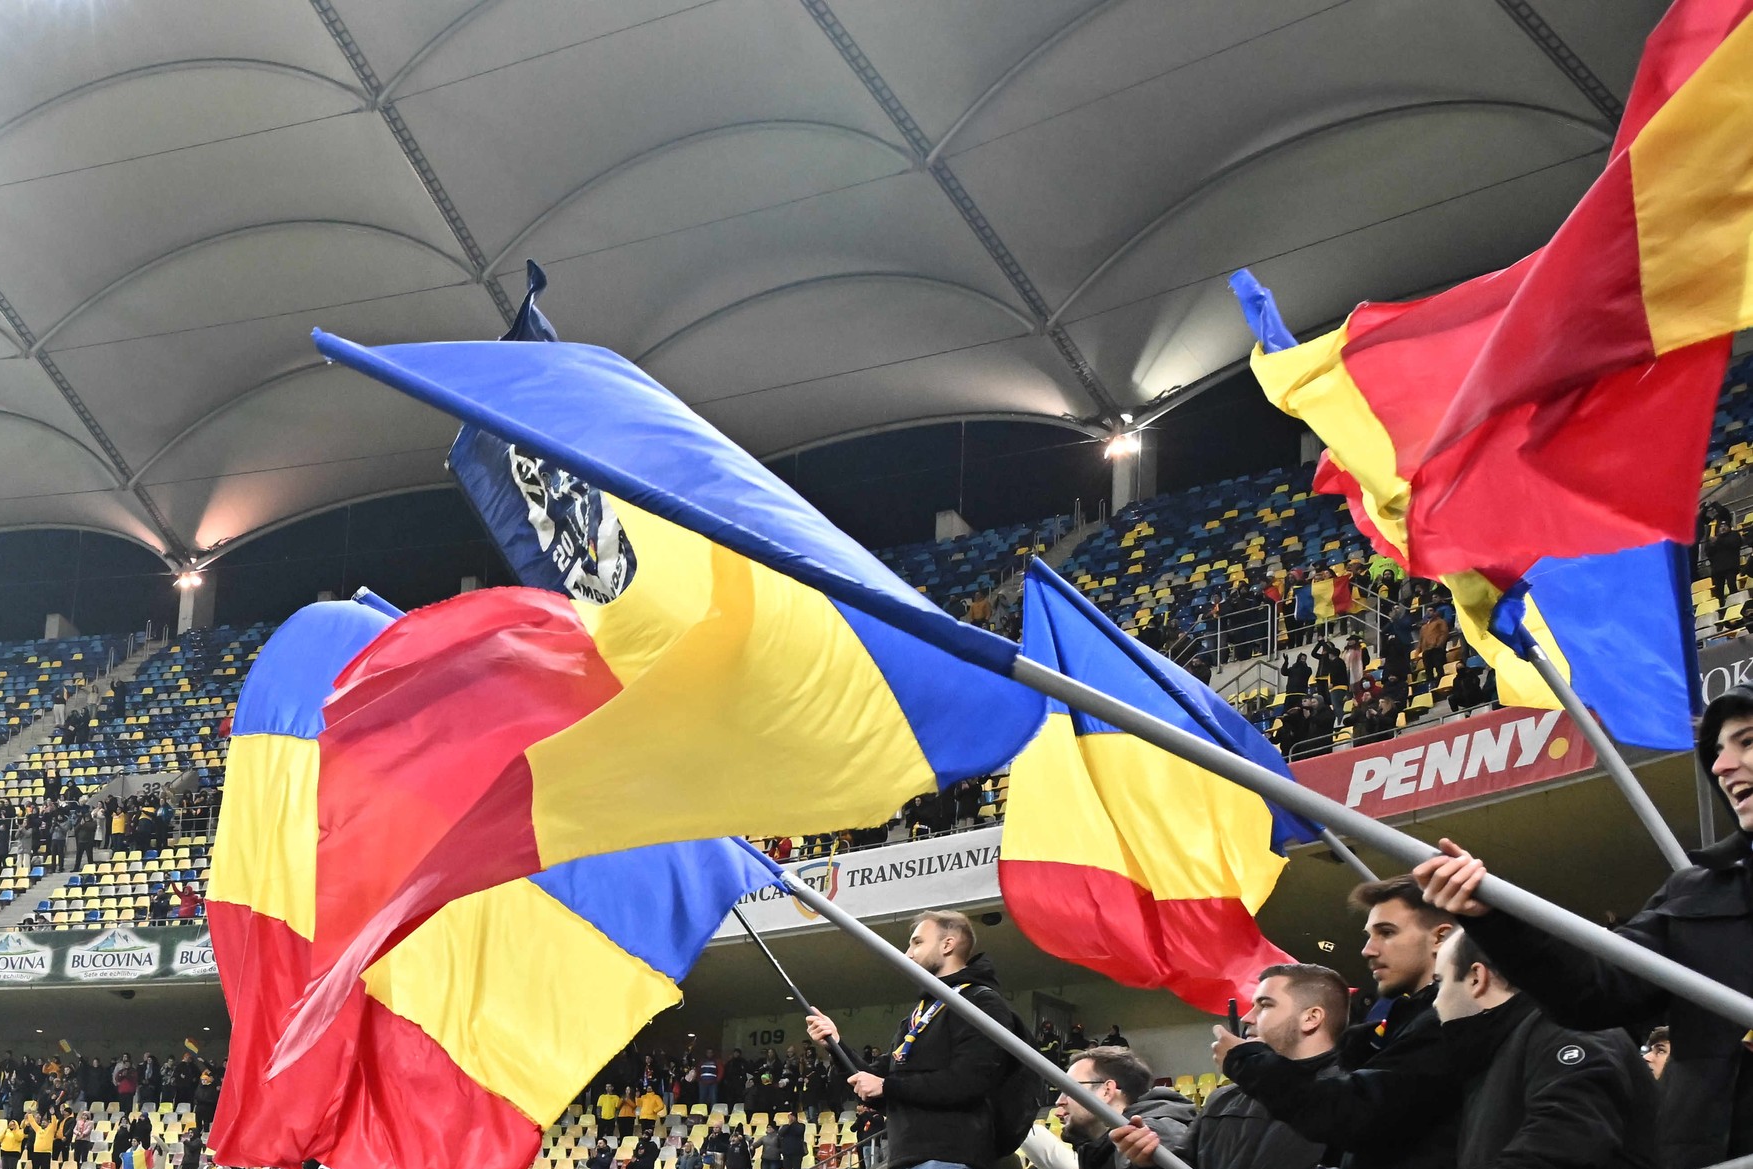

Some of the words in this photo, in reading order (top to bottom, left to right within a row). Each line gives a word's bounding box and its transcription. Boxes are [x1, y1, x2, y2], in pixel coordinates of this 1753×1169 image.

[1699, 657, 1753, 706] OK
[846, 846, 1001, 888] TRANSILVANIA
[71, 952, 153, 969] BUCOVINA
[748, 1028, 785, 1047] 109
